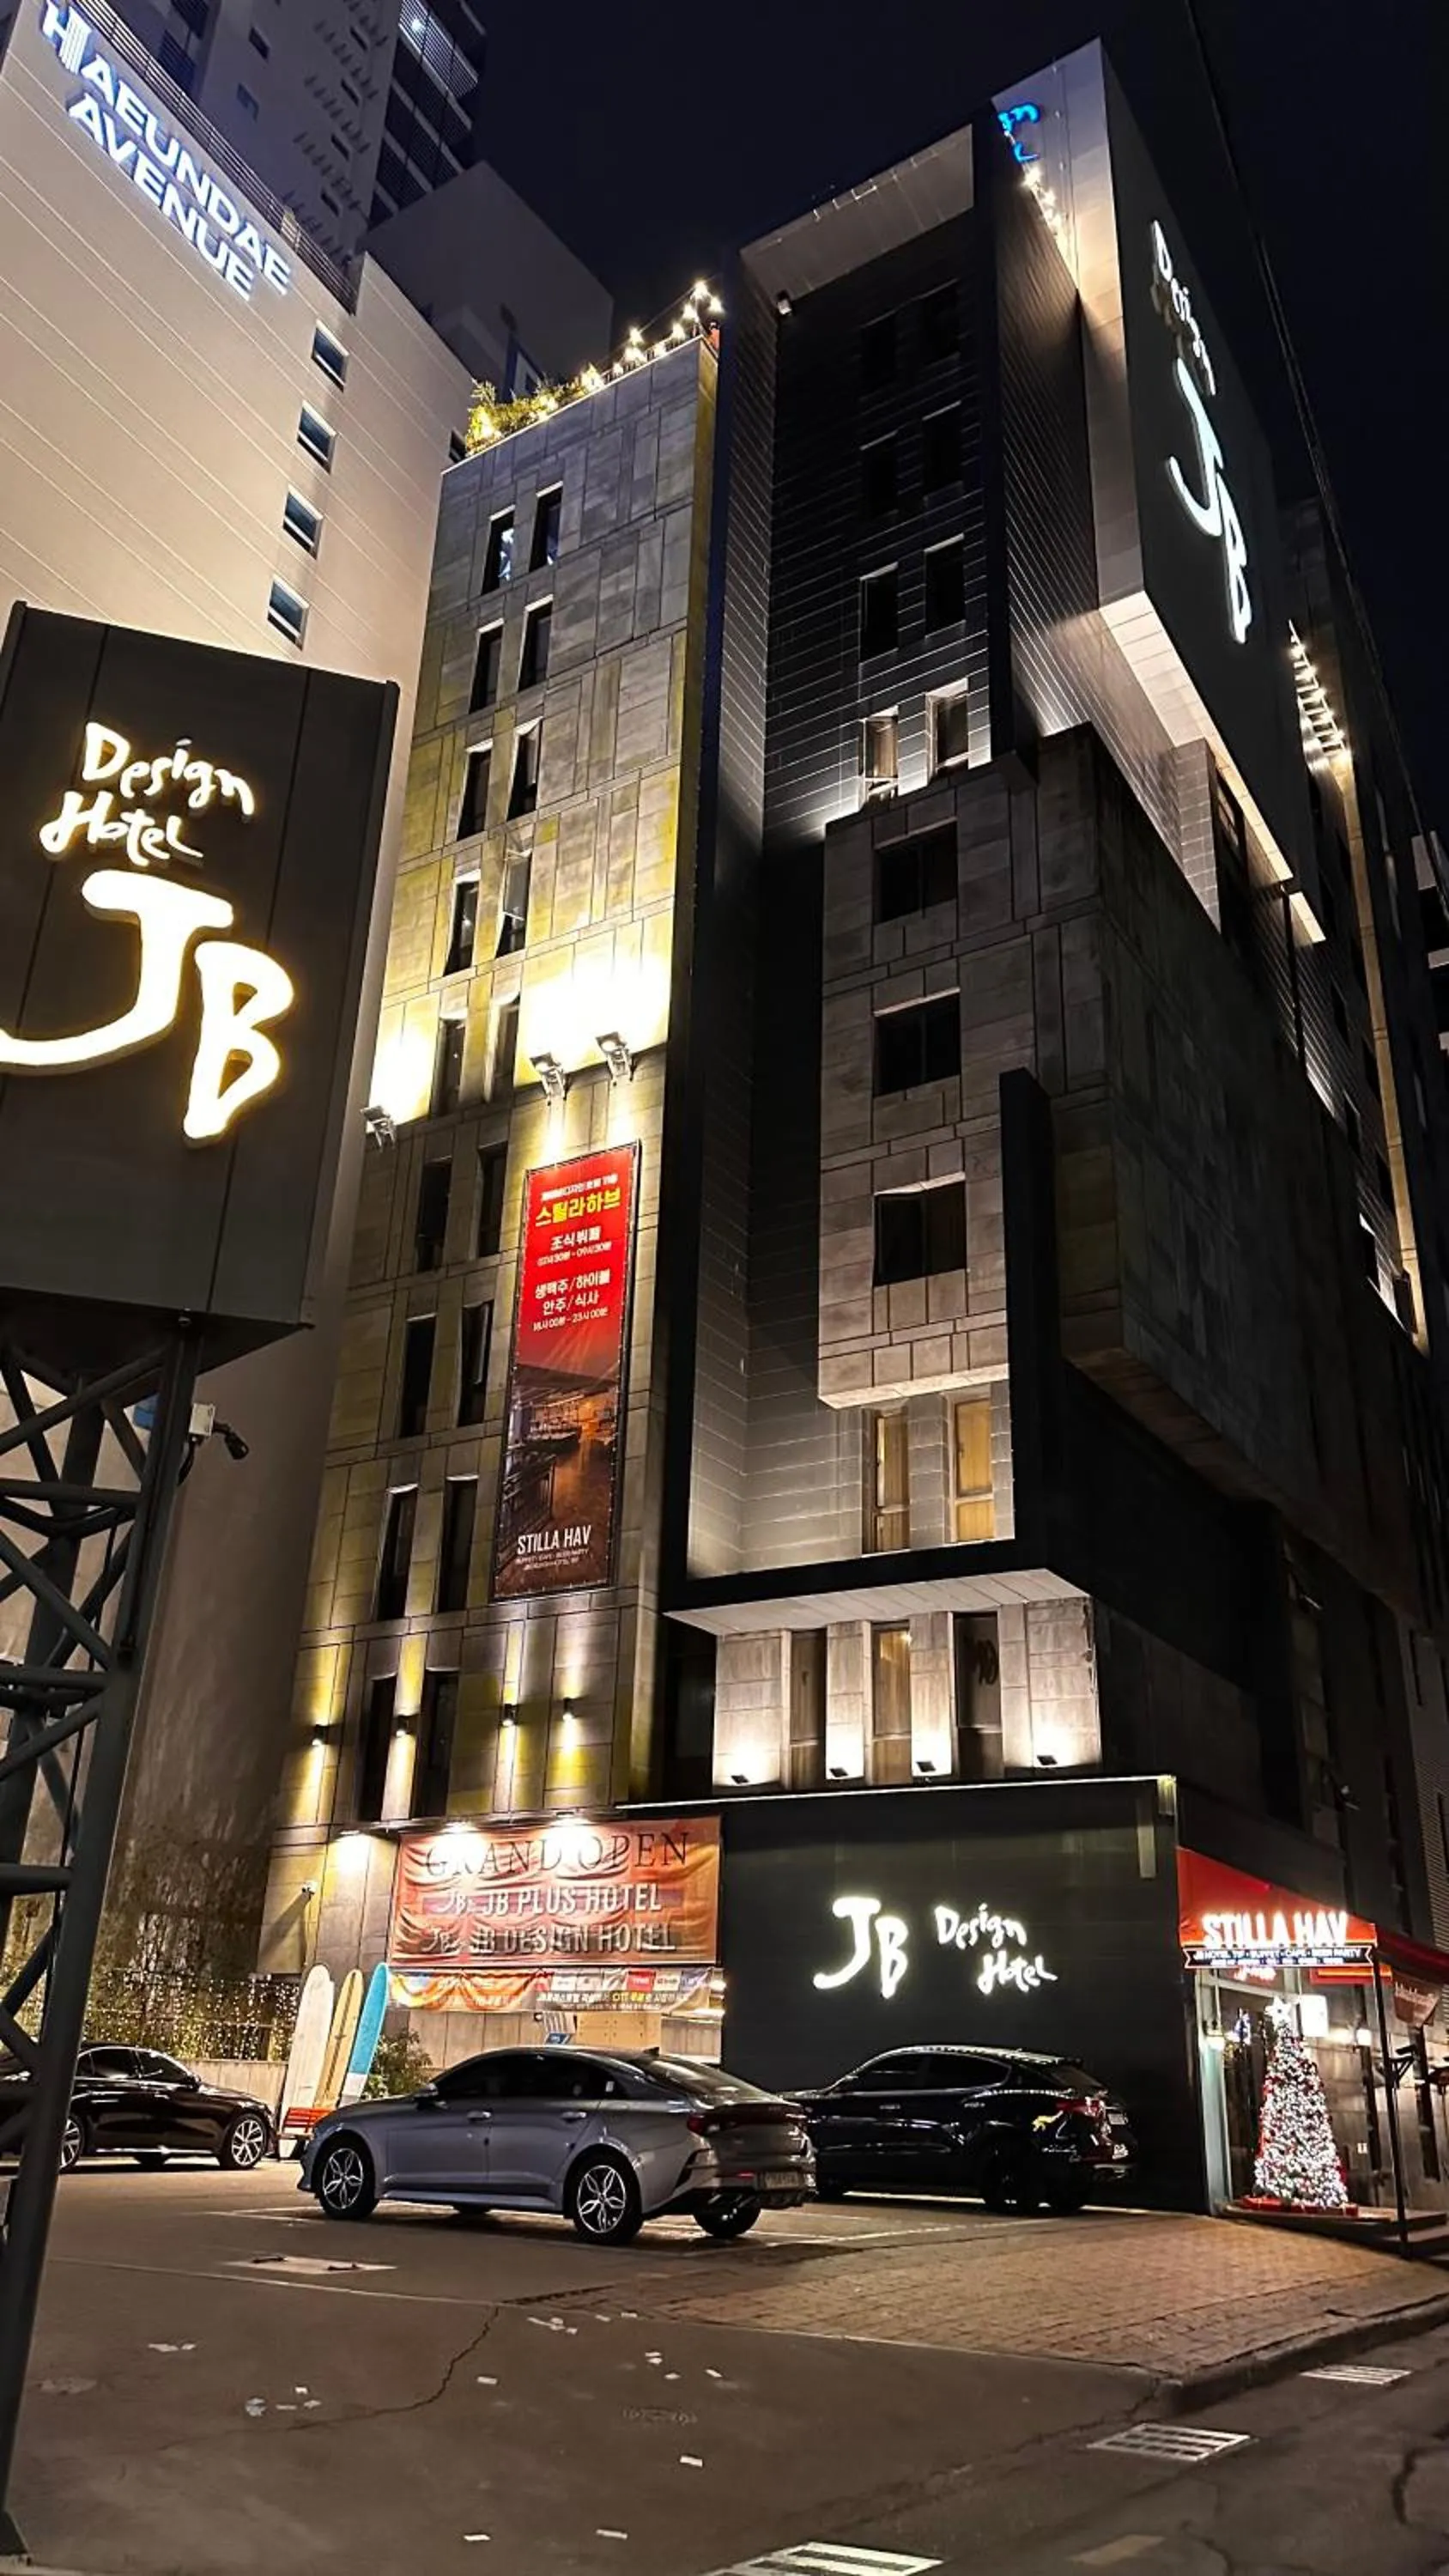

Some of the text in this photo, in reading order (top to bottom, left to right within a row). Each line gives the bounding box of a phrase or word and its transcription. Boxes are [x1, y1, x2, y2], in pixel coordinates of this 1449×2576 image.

[42, 0, 291, 296] HAEUNDAE
[68, 92, 254, 301] AVENUE
[1166, 355, 1252, 645] JB
[82, 721, 256, 817] Design
[39, 790, 204, 867] Hotel
[0, 869, 294, 1142] JB
[517, 1524, 591, 1555] STILLA HAV
[577, 1831, 690, 1874] OPEN
[483, 1889, 509, 1917] JB
[518, 1886, 577, 1917] PLUS
[585, 1882, 664, 1914] HOTEL
[597, 1922, 676, 1952] HOTEL
[1203, 1910, 1349, 1948] STILLA HAV
[813, 1896, 1028, 1999] JB Design
[977, 1950, 1058, 1996] Hotel
